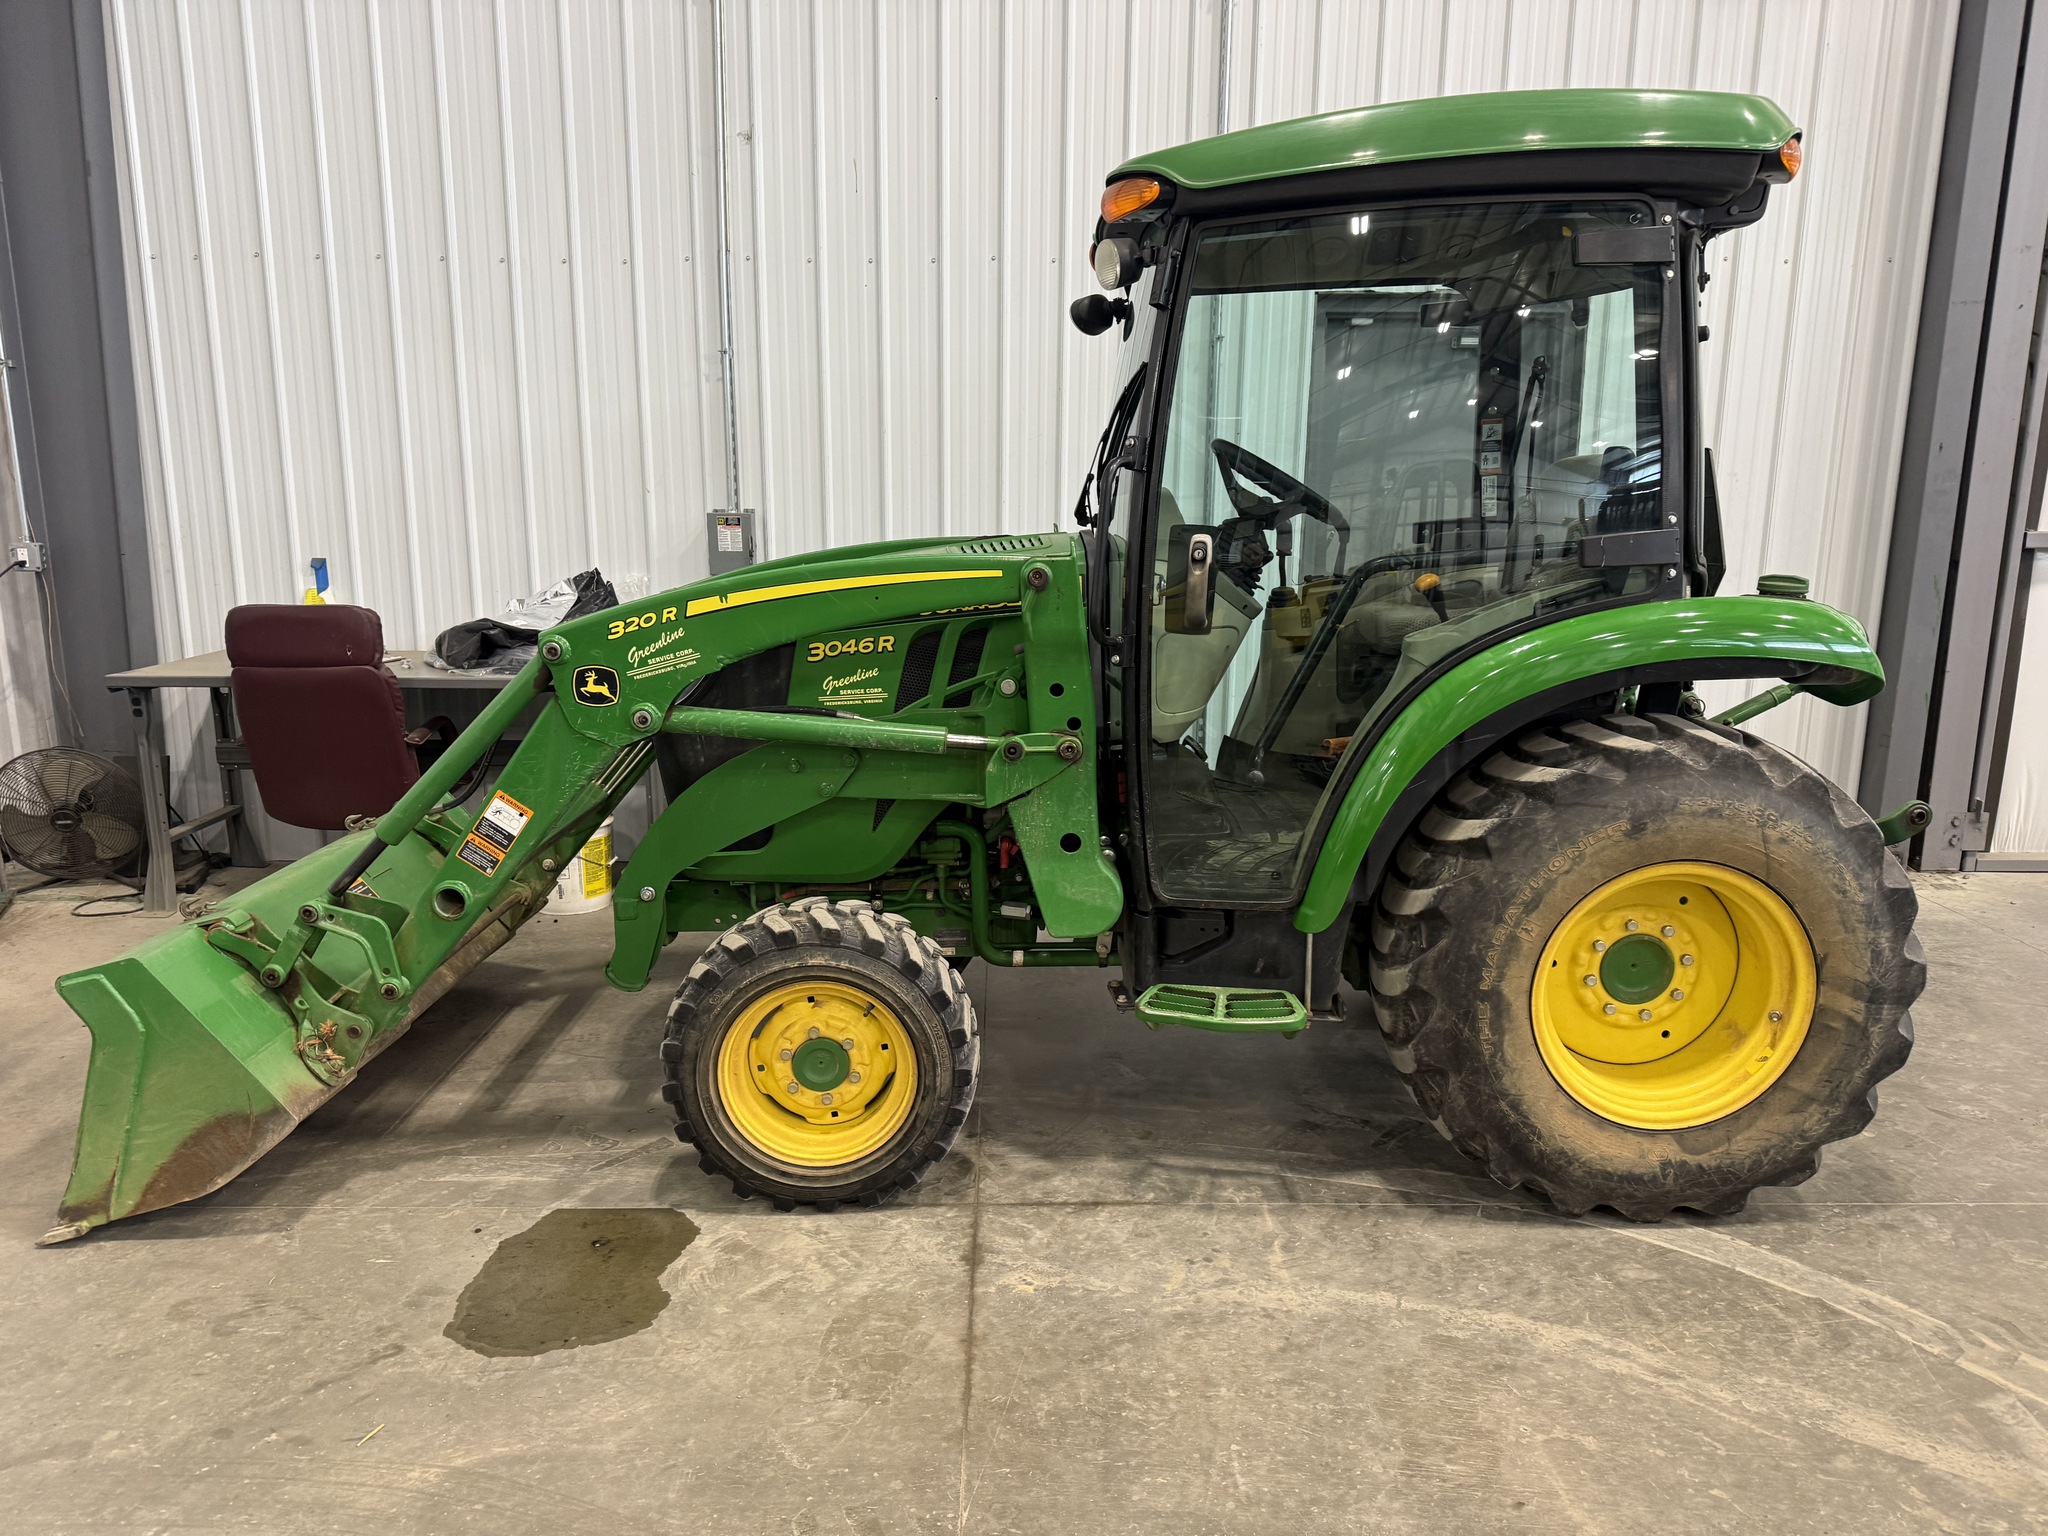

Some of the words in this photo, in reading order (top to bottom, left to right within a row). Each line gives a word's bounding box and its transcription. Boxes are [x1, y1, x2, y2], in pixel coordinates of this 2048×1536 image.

[607, 612, 657, 640] 320
[661, 606, 678, 625] R
[628, 627, 685, 668] Greenline
[647, 653, 675, 665] SERVICE
[675, 648, 695, 659] CORP.
[807, 637, 875, 662] 3046
[877, 635, 896, 653] R
[823, 667, 880, 695] Greenline
[839, 688, 865, 696] SERVICE
[505, 797, 529, 815] WARNING
[477, 841, 501, 858] WARNING
[1480, 820, 1631, 991] MARATHONER
